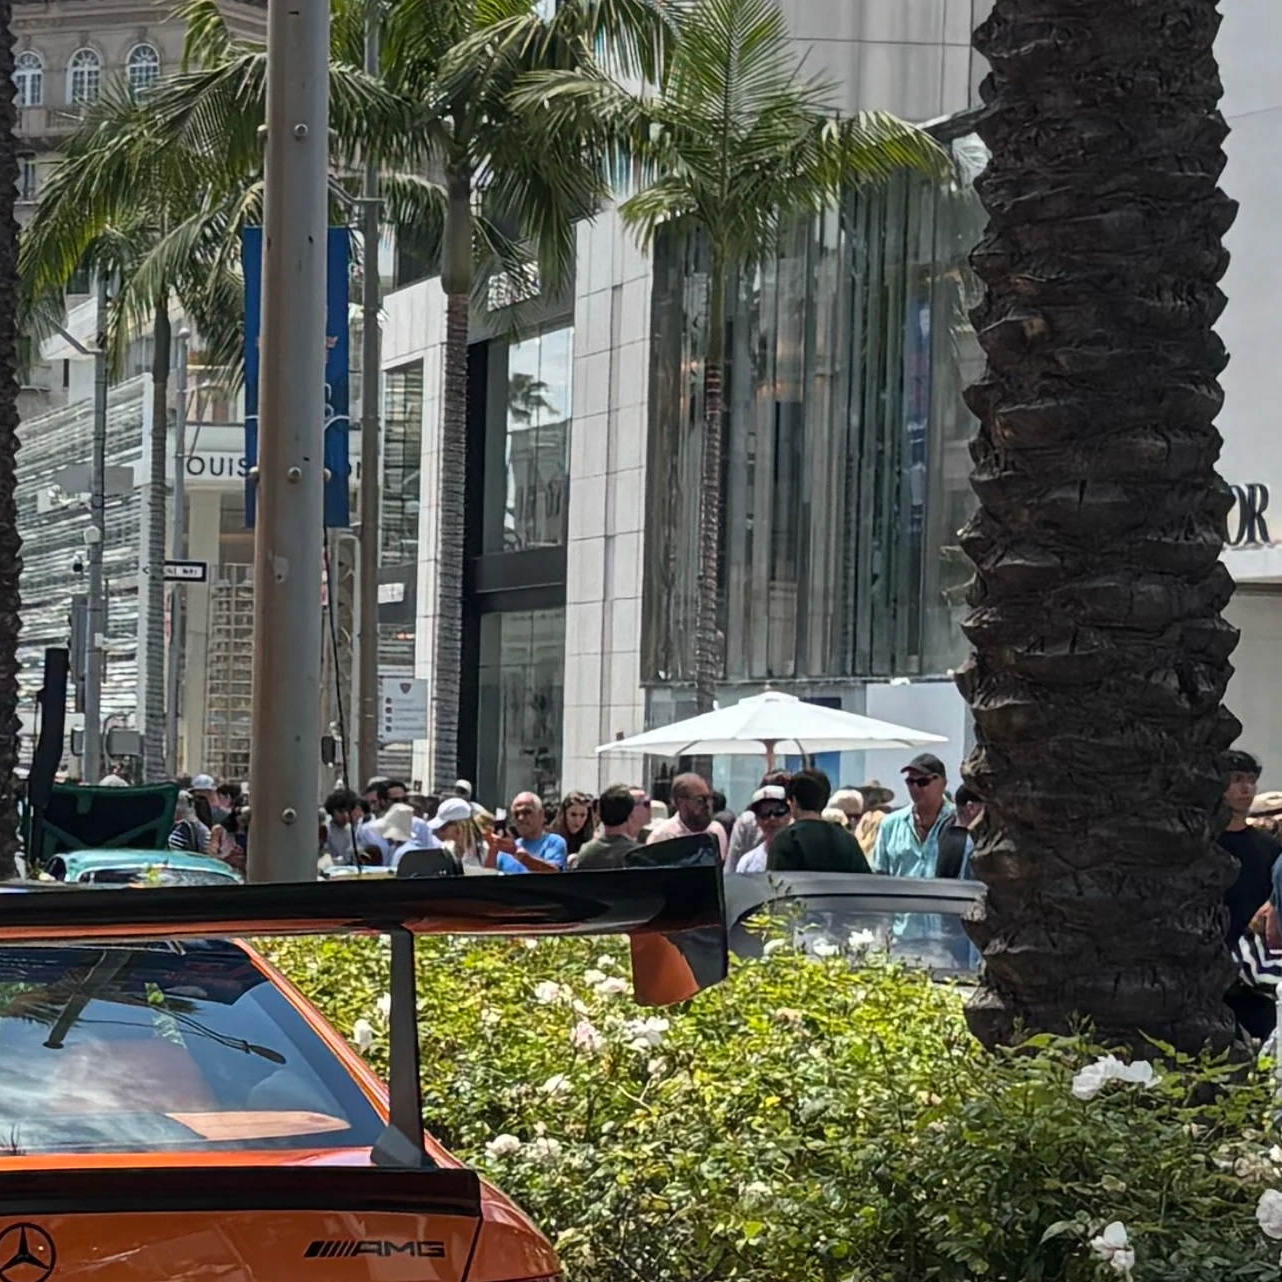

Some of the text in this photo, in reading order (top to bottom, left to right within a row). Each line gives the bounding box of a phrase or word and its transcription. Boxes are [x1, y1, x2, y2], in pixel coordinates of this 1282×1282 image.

[186, 455, 249, 478] OUIS
[1224, 483, 1273, 546] OR
[349, 1241, 446, 1258] AMG
